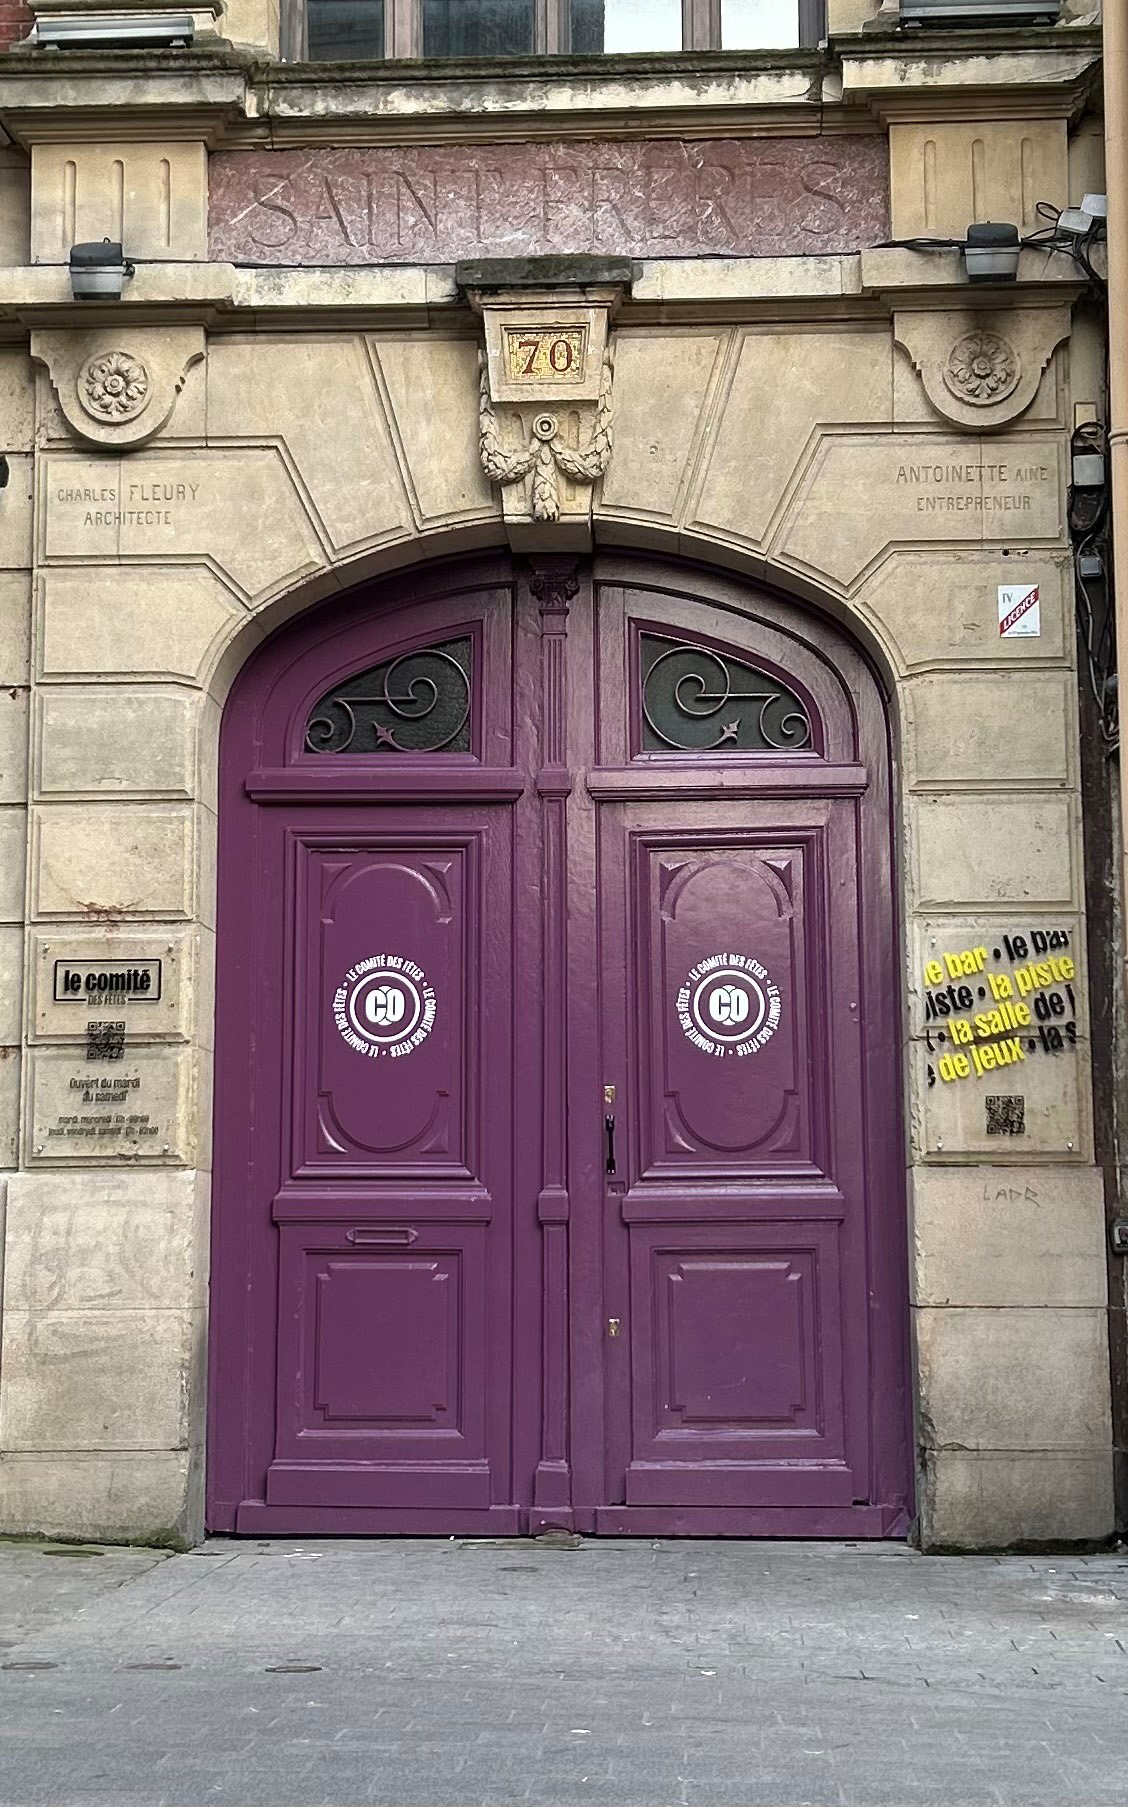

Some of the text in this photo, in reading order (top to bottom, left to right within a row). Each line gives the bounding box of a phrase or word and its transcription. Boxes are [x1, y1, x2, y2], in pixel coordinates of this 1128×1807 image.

[249, 167, 505, 249] SAINT
[518, 339, 574, 375] 70
[895, 464, 1008, 484] ANTOINETTE
[57, 483, 201, 502] CHARLES FLEURY
[916, 494, 1032, 512] ENTREPRENEUR
[83, 510, 172, 526] ARCHITECTE
[1002, 592, 1014, 604] IV
[1003, 591, 1036, 631] LICENCE
[345, 968, 359, 982] LE
[354, 953, 386, 975] COMITÉ
[386, 955, 403, 969] DES
[688, 952, 768, 982] LE COMITÉ DES FÊTES
[943, 944, 988, 979] bar
[1002, 934, 1030, 961] le
[64, 968, 151, 992] le comité
[766, 985, 780, 997] LE
[987, 973, 1014, 1000] la
[1014, 956, 1075, 997] piste
[87, 994, 103, 1006] DES
[947, 1018, 974, 1045] la
[974, 1001, 1031, 1038] salle
[1033, 991, 1065, 1021] de
[938, 1052, 971, 1081] de
[969, 1037, 1026, 1077] jeux
[1038, 1025, 1064, 1052] la
